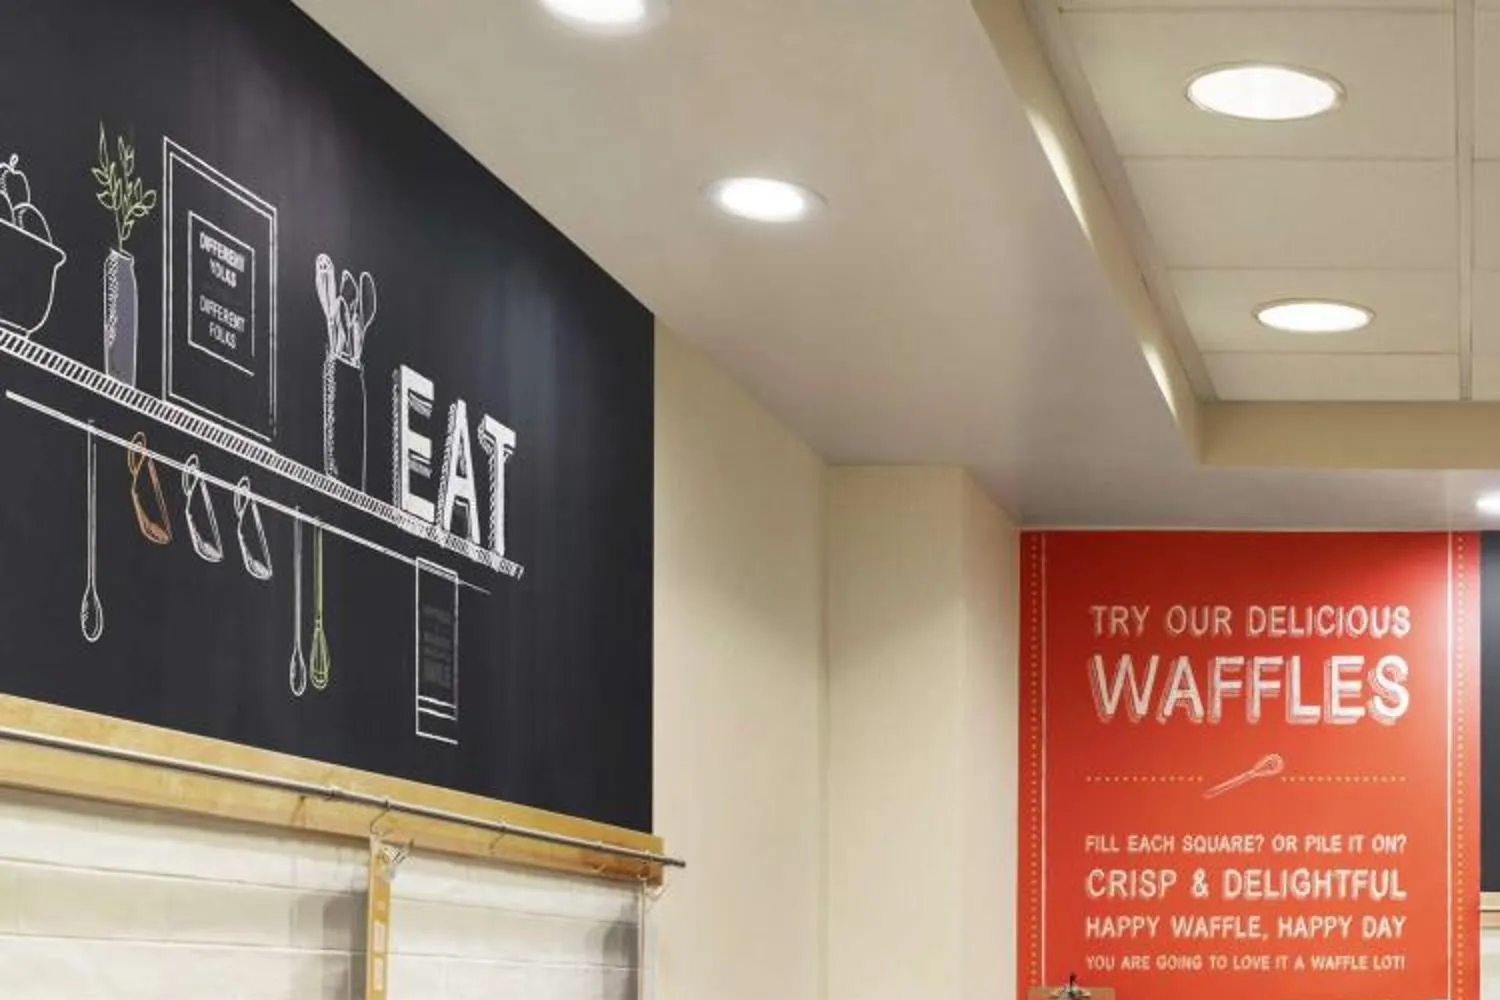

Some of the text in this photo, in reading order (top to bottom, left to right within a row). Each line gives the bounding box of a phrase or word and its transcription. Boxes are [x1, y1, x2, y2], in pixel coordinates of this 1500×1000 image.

[200, 231, 246, 273] DIFFERENT
[209, 257, 237, 288] YOLKS
[200, 294, 246, 333] DIFFERENT
[209, 320, 237, 349] FOLKS
[392, 363, 517, 557] EAT
[1090, 605, 1411, 637] TRY OUR DELICIOUS
[1088, 654, 1410, 725] WAFFLES
[1085, 834, 1407, 854] FILL EACH SQUARE? OR PILE IT ON?
[1086, 868, 1407, 901] CRISP & DELIGHTFUL
[1086, 915, 1407, 940] HAPPY WAFFLE, HAPPY DAY
[1086, 955, 1406, 971] YOU ARE GOING TO LOVE IT A WAFFLE LOT!
